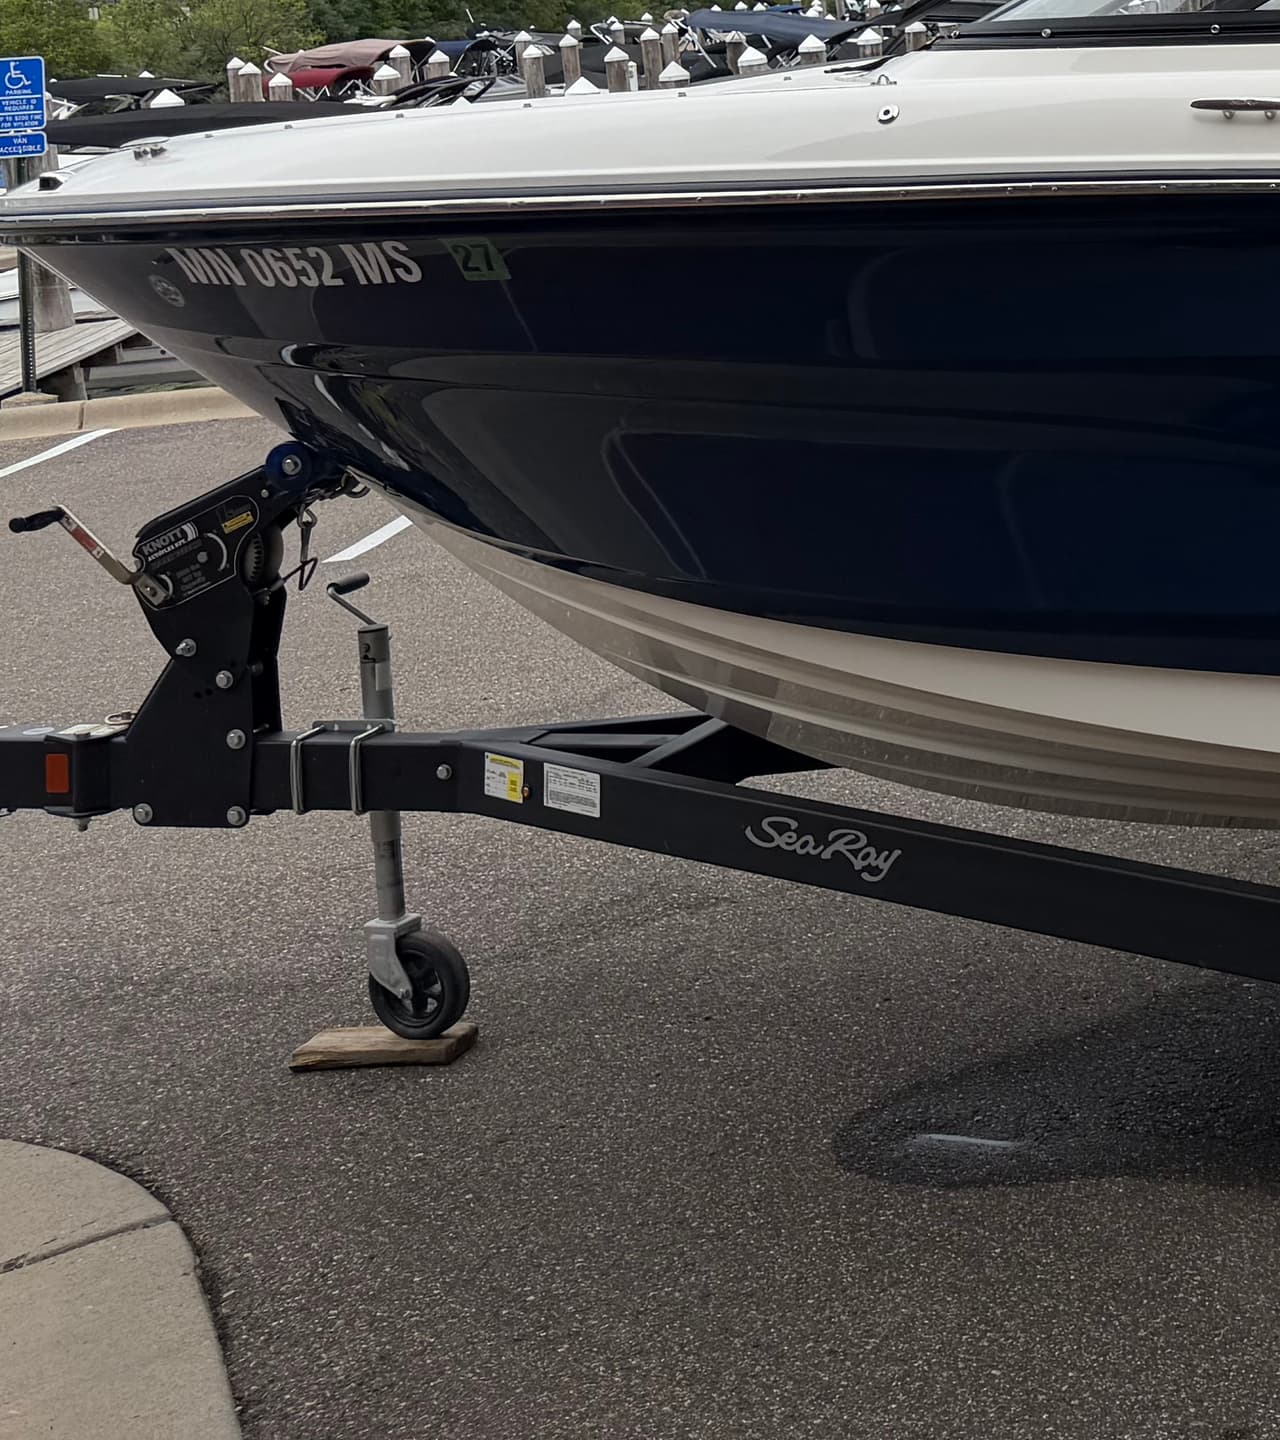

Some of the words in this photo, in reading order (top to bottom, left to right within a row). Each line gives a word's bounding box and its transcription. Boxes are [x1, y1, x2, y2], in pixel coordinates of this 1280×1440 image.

[164, 247, 248, 287] MN
[240, 246, 345, 287] 0652
[338, 241, 423, 285] MS
[450, 244, 494, 271] 27
[142, 527, 183, 555] KNOTT
[744, 816, 825, 856] Sea
[820, 828, 902, 882] Ray
